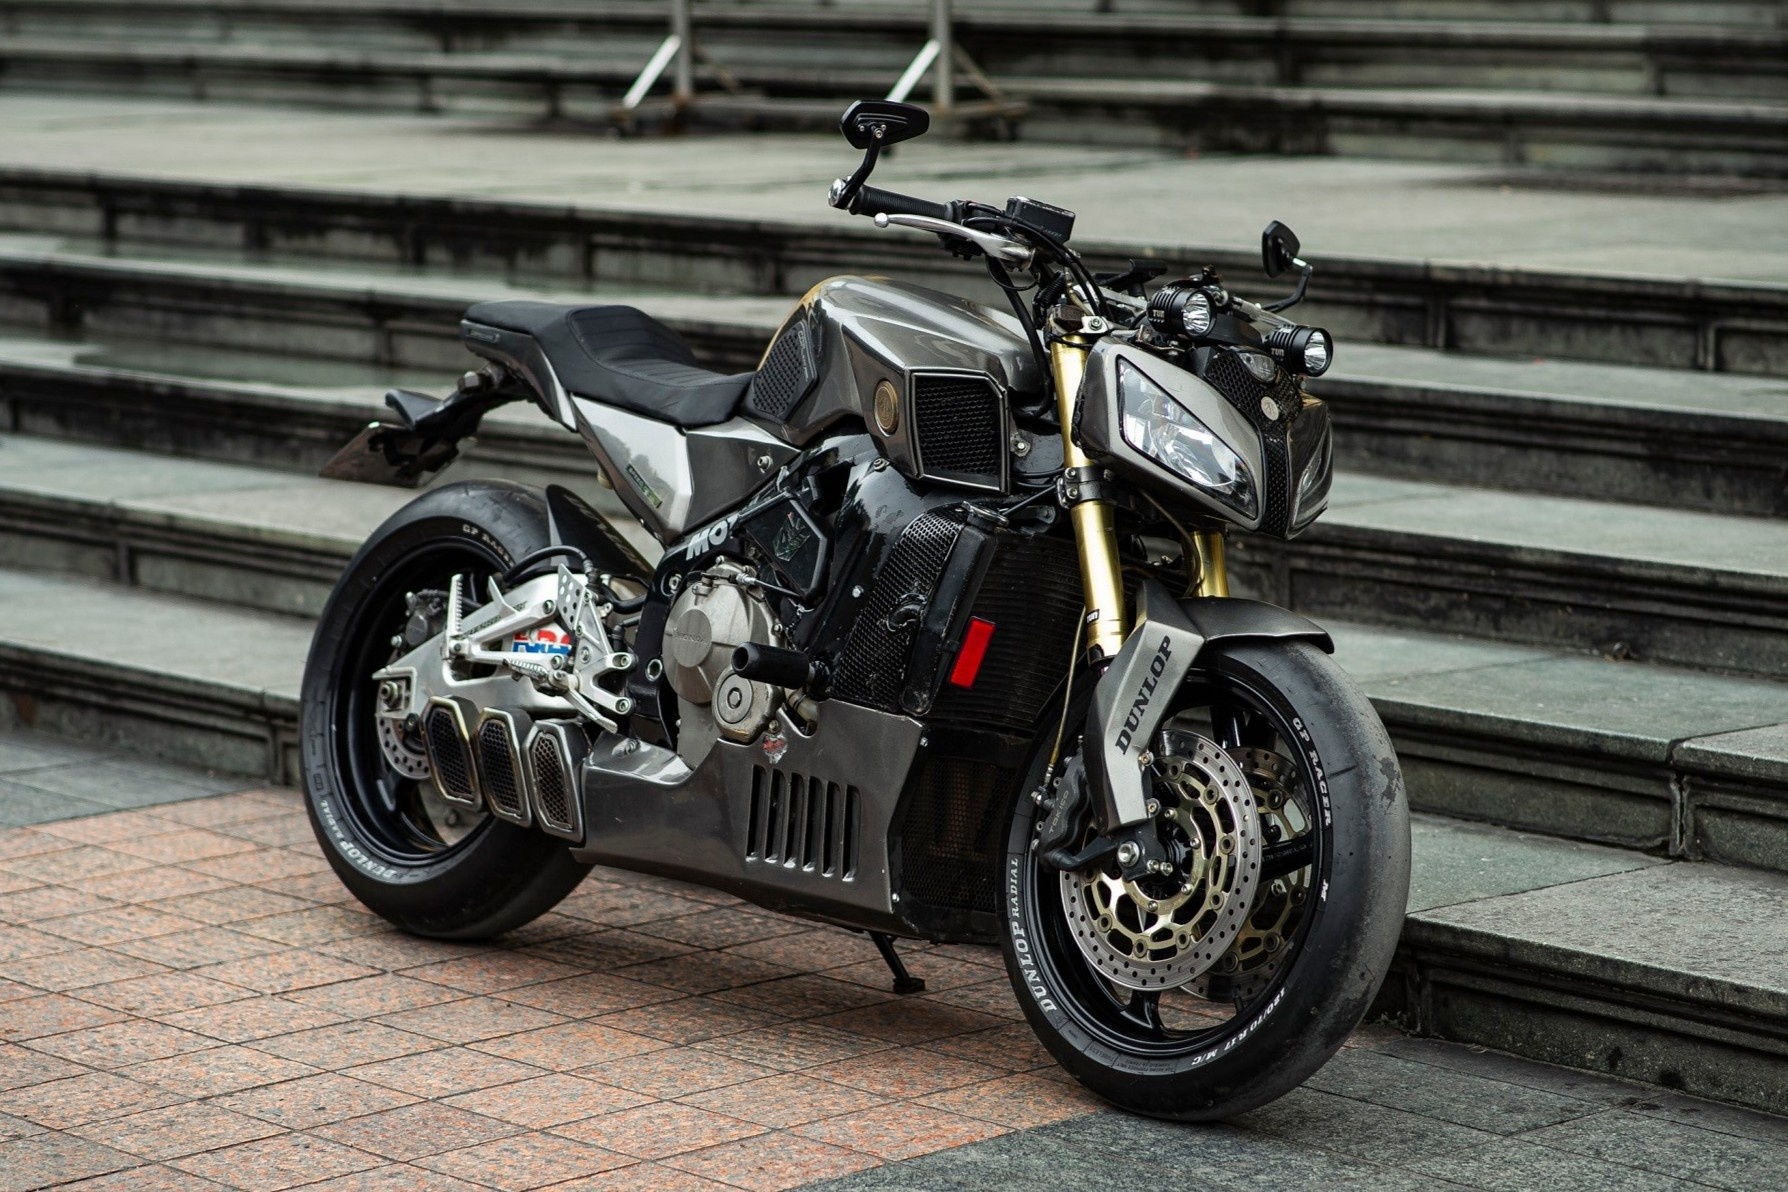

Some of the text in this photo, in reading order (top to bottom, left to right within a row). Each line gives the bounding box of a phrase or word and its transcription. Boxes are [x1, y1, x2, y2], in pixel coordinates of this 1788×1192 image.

[685, 507, 747, 561] MOT
[1115, 635, 1172, 756] DUNLOP
[1049, 790, 1069, 834] TOKICO
[1292, 717, 1332, 827] GP RACER
[340, 840, 398, 878] DUNLOP
[1010, 857, 1058, 1013] DUNLOP RADIAL
